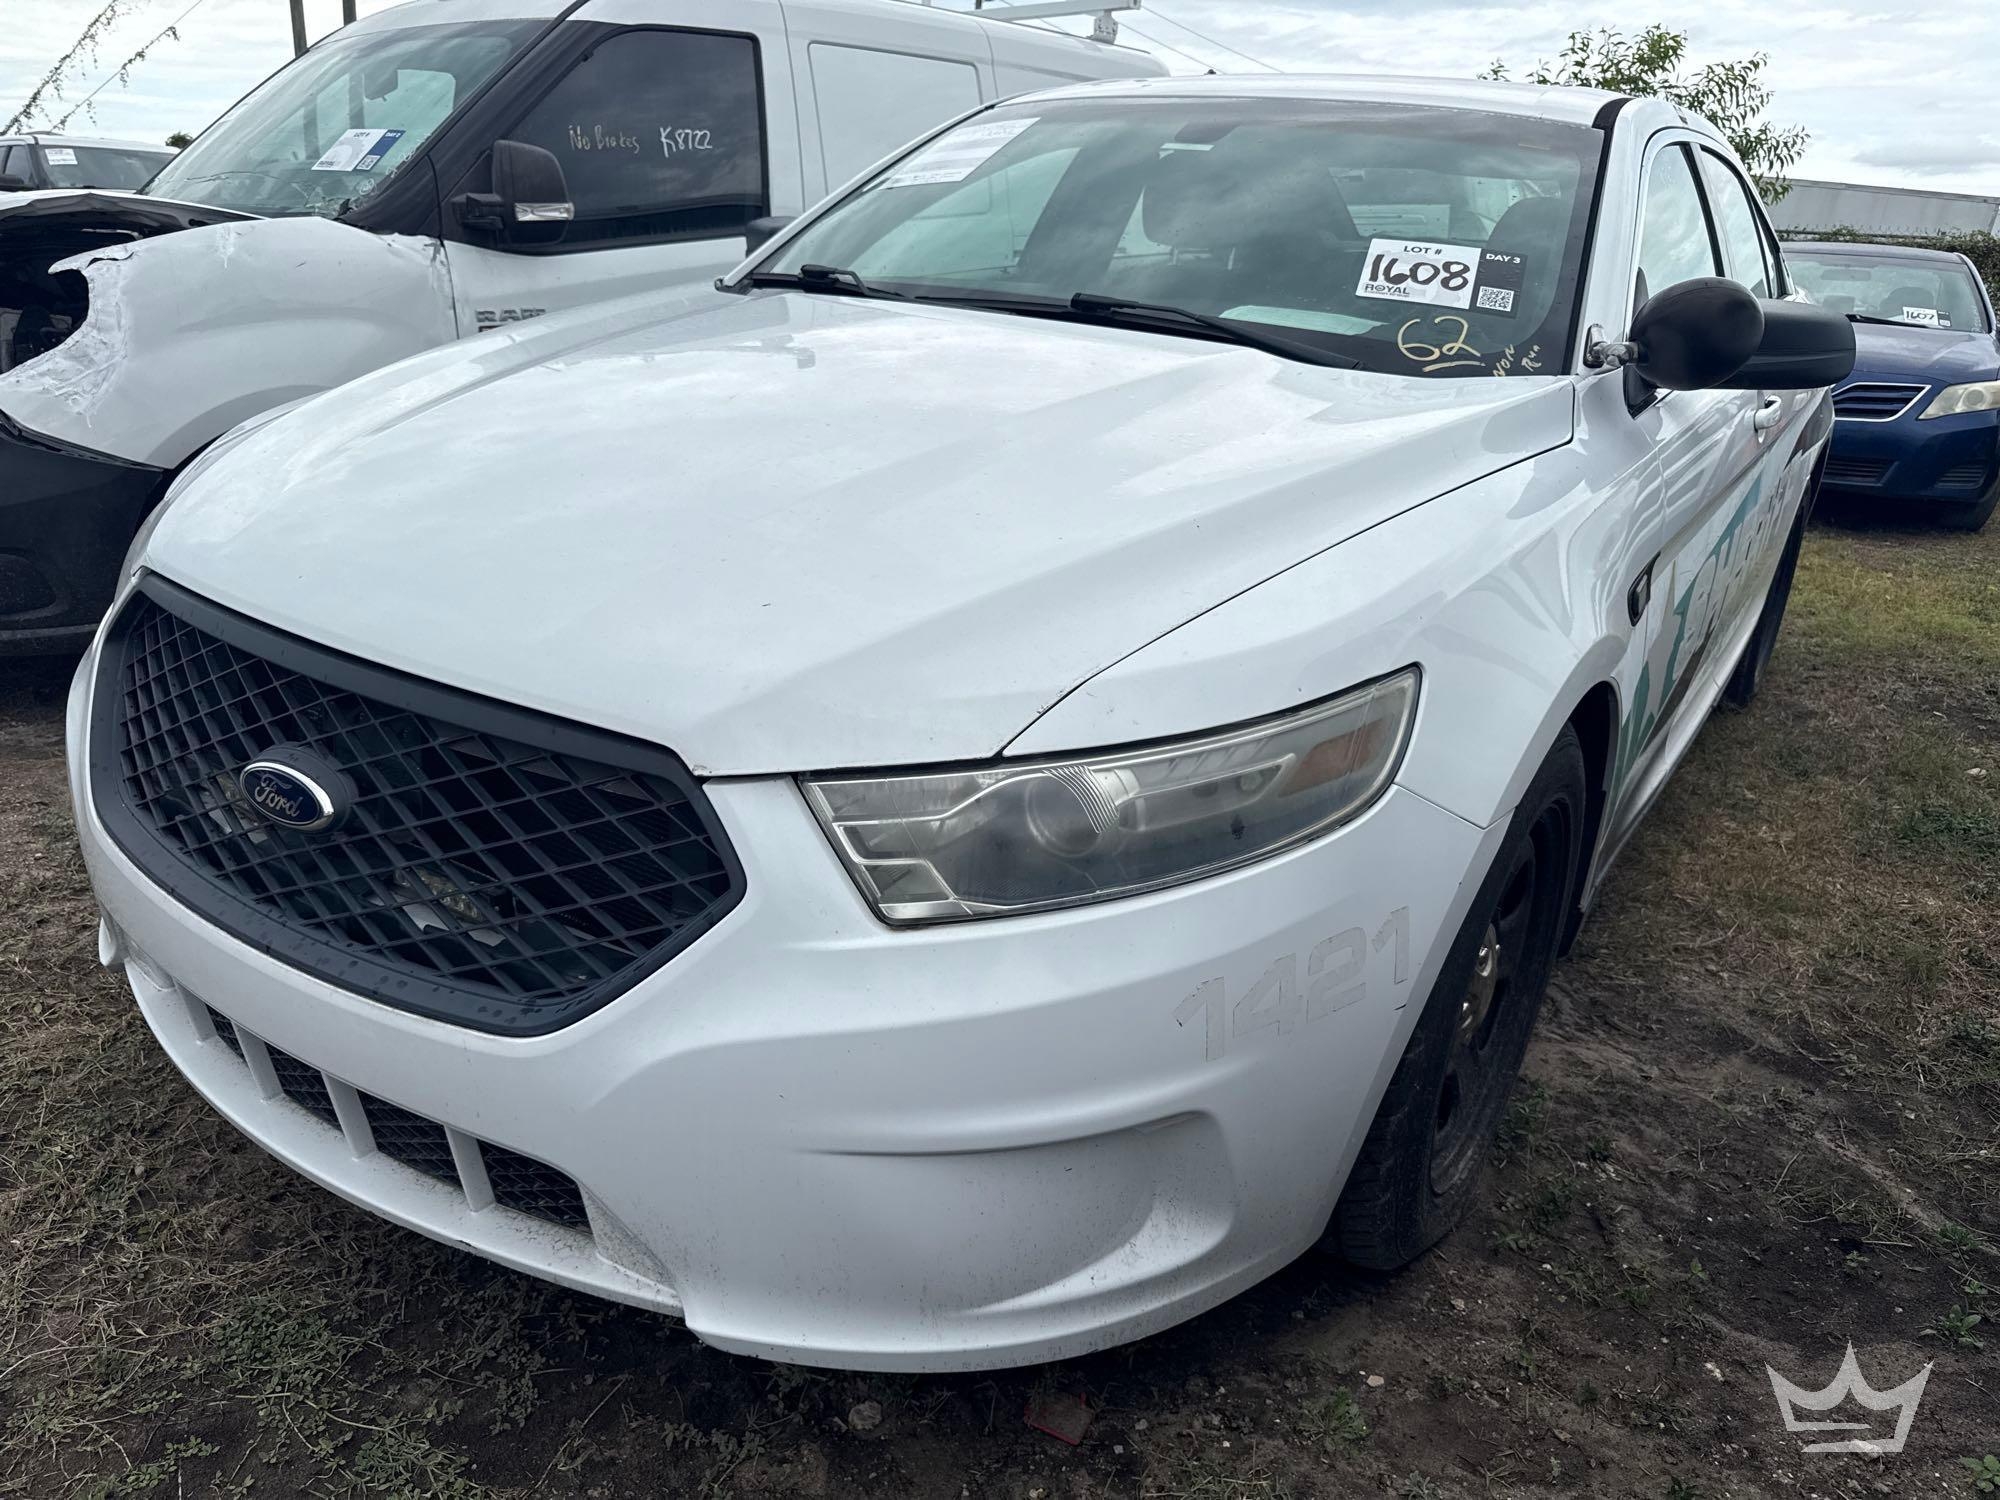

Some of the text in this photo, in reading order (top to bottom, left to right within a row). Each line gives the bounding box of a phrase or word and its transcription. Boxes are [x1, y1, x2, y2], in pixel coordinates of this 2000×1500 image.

[568, 125, 591, 150] No
[659, 126, 713, 158] K8722
[1403, 246, 1431, 254] LOT
[1486, 253, 1521, 264] DAY 3
[1364, 283, 1410, 295] ROYAL
[1368, 254, 1471, 292] 1608
[1906, 310, 1935, 320] 1607
[1397, 315, 1481, 362] 62
[254, 773, 304, 818] Ford
[1170, 905, 1410, 1062] 1421
